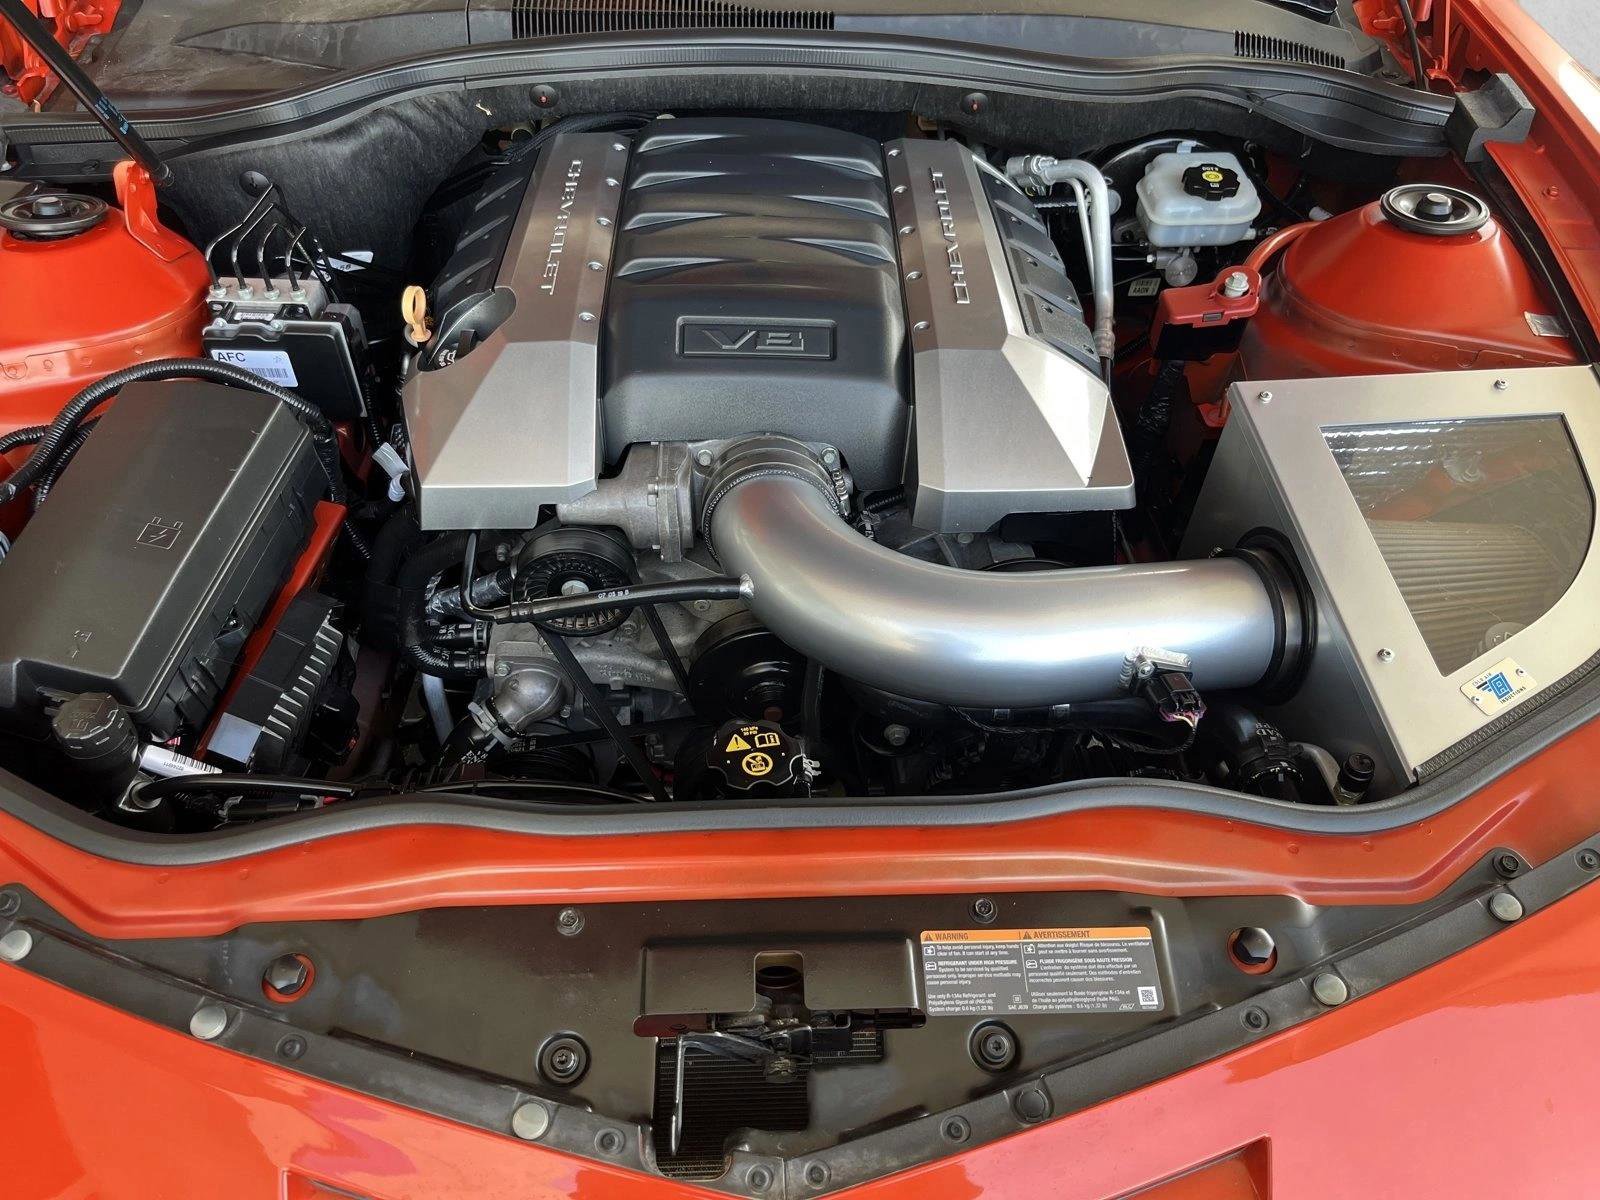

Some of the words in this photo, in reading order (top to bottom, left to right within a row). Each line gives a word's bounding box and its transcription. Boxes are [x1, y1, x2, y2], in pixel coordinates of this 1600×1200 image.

[541, 160, 583, 295] CHEVROLET
[929, 167, 970, 304] CHEVROLET
[701, 328, 805, 351] V8
[217, 352, 246, 362] AFC
[1500, 686, 1526, 704] INDUCTIONS
[1033, 931, 1090, 939] AVERTISSEMENT
